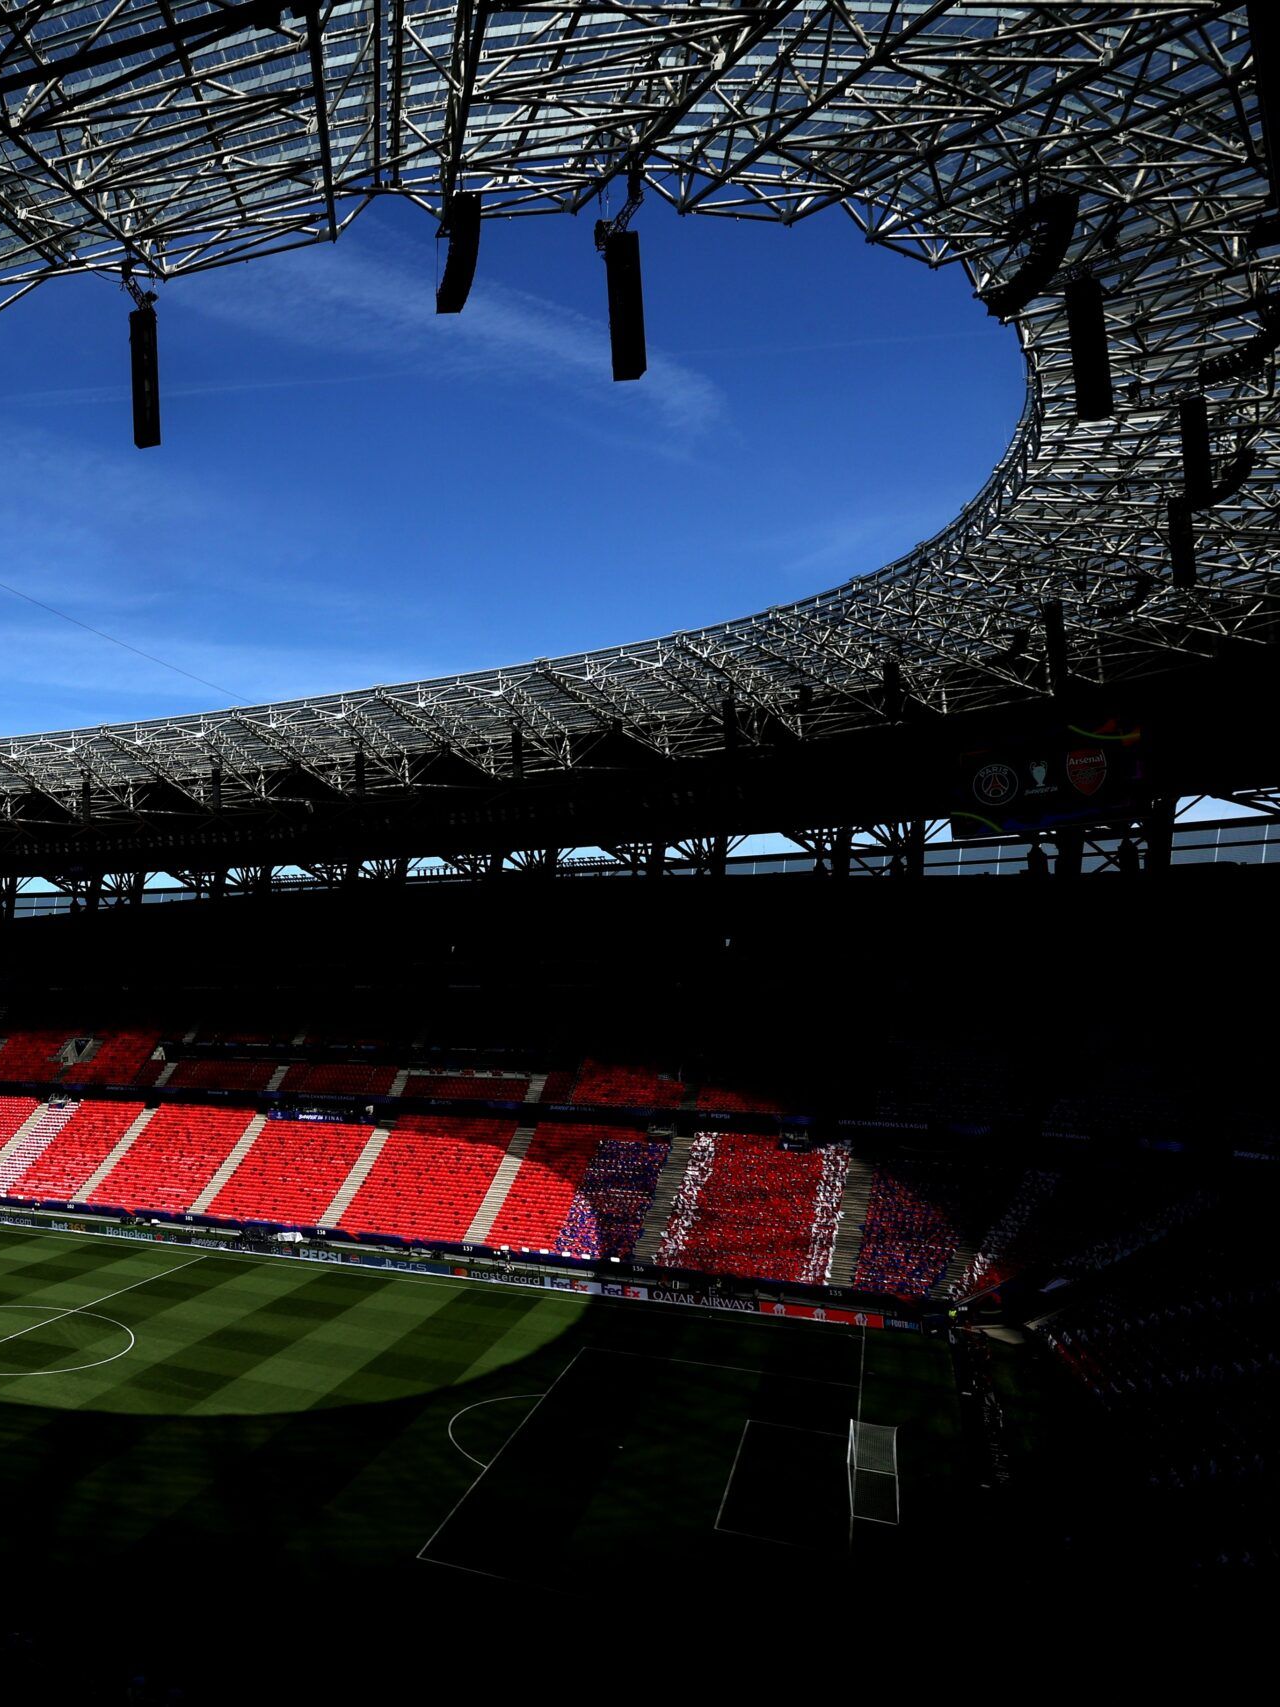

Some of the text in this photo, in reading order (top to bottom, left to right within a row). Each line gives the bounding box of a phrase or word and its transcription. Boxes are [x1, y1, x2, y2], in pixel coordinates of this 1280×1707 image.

[1069, 754, 1103, 765] Arsenal
[979, 766, 1008, 778] PARIS
[51, 1220, 86, 1232] bet365
[106, 1226, 153, 1241] Heineken
[229, 1242, 256, 1251] FINAL
[299, 1248, 342, 1263] PEPSI
[397, 1261, 427, 1272] PS5
[471, 1270, 540, 1286] mastercard
[551, 1279, 589, 1292] FedEx
[601, 1282, 641, 1299] FedEx
[653, 1290, 754, 1311] QATAR AIRWAYS
